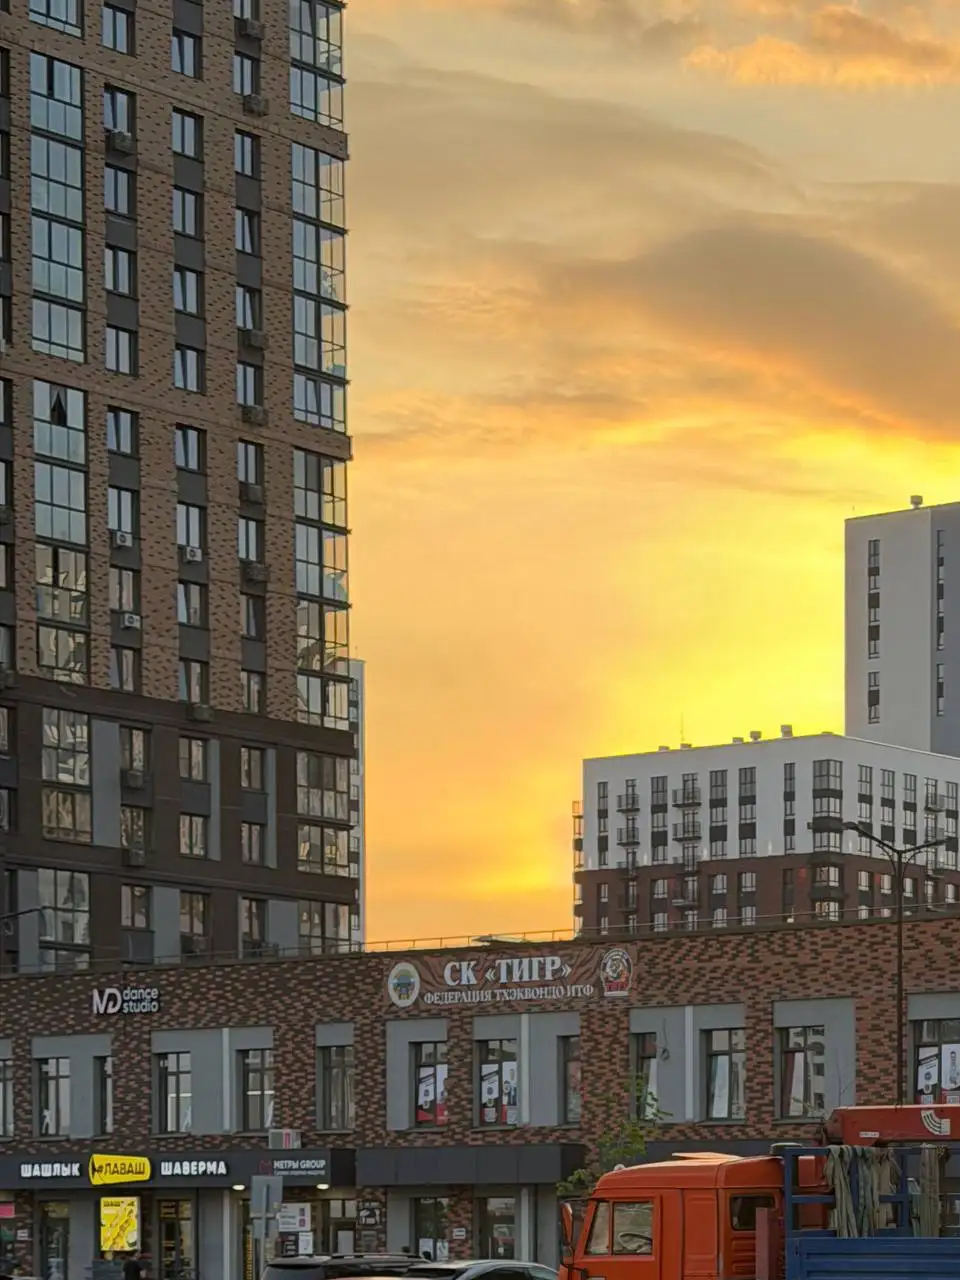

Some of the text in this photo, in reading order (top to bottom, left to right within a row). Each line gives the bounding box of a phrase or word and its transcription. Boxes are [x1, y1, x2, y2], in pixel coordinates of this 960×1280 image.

[443, 955, 573, 986] СК «ТИГР»
[123, 987, 159, 1000] dance
[423, 988, 493, 1006] ФЕДЕРАЦИЯ
[496, 985, 565, 1004] ТХЭКВОНДО
[566, 983, 594, 999] ИТФ
[122, 999, 159, 1014] studio
[20, 1162, 81, 1178] ШАШЛЫК
[160, 1161, 227, 1176] ШАВЕРМА
[300, 1159, 326, 1169] GROUP
